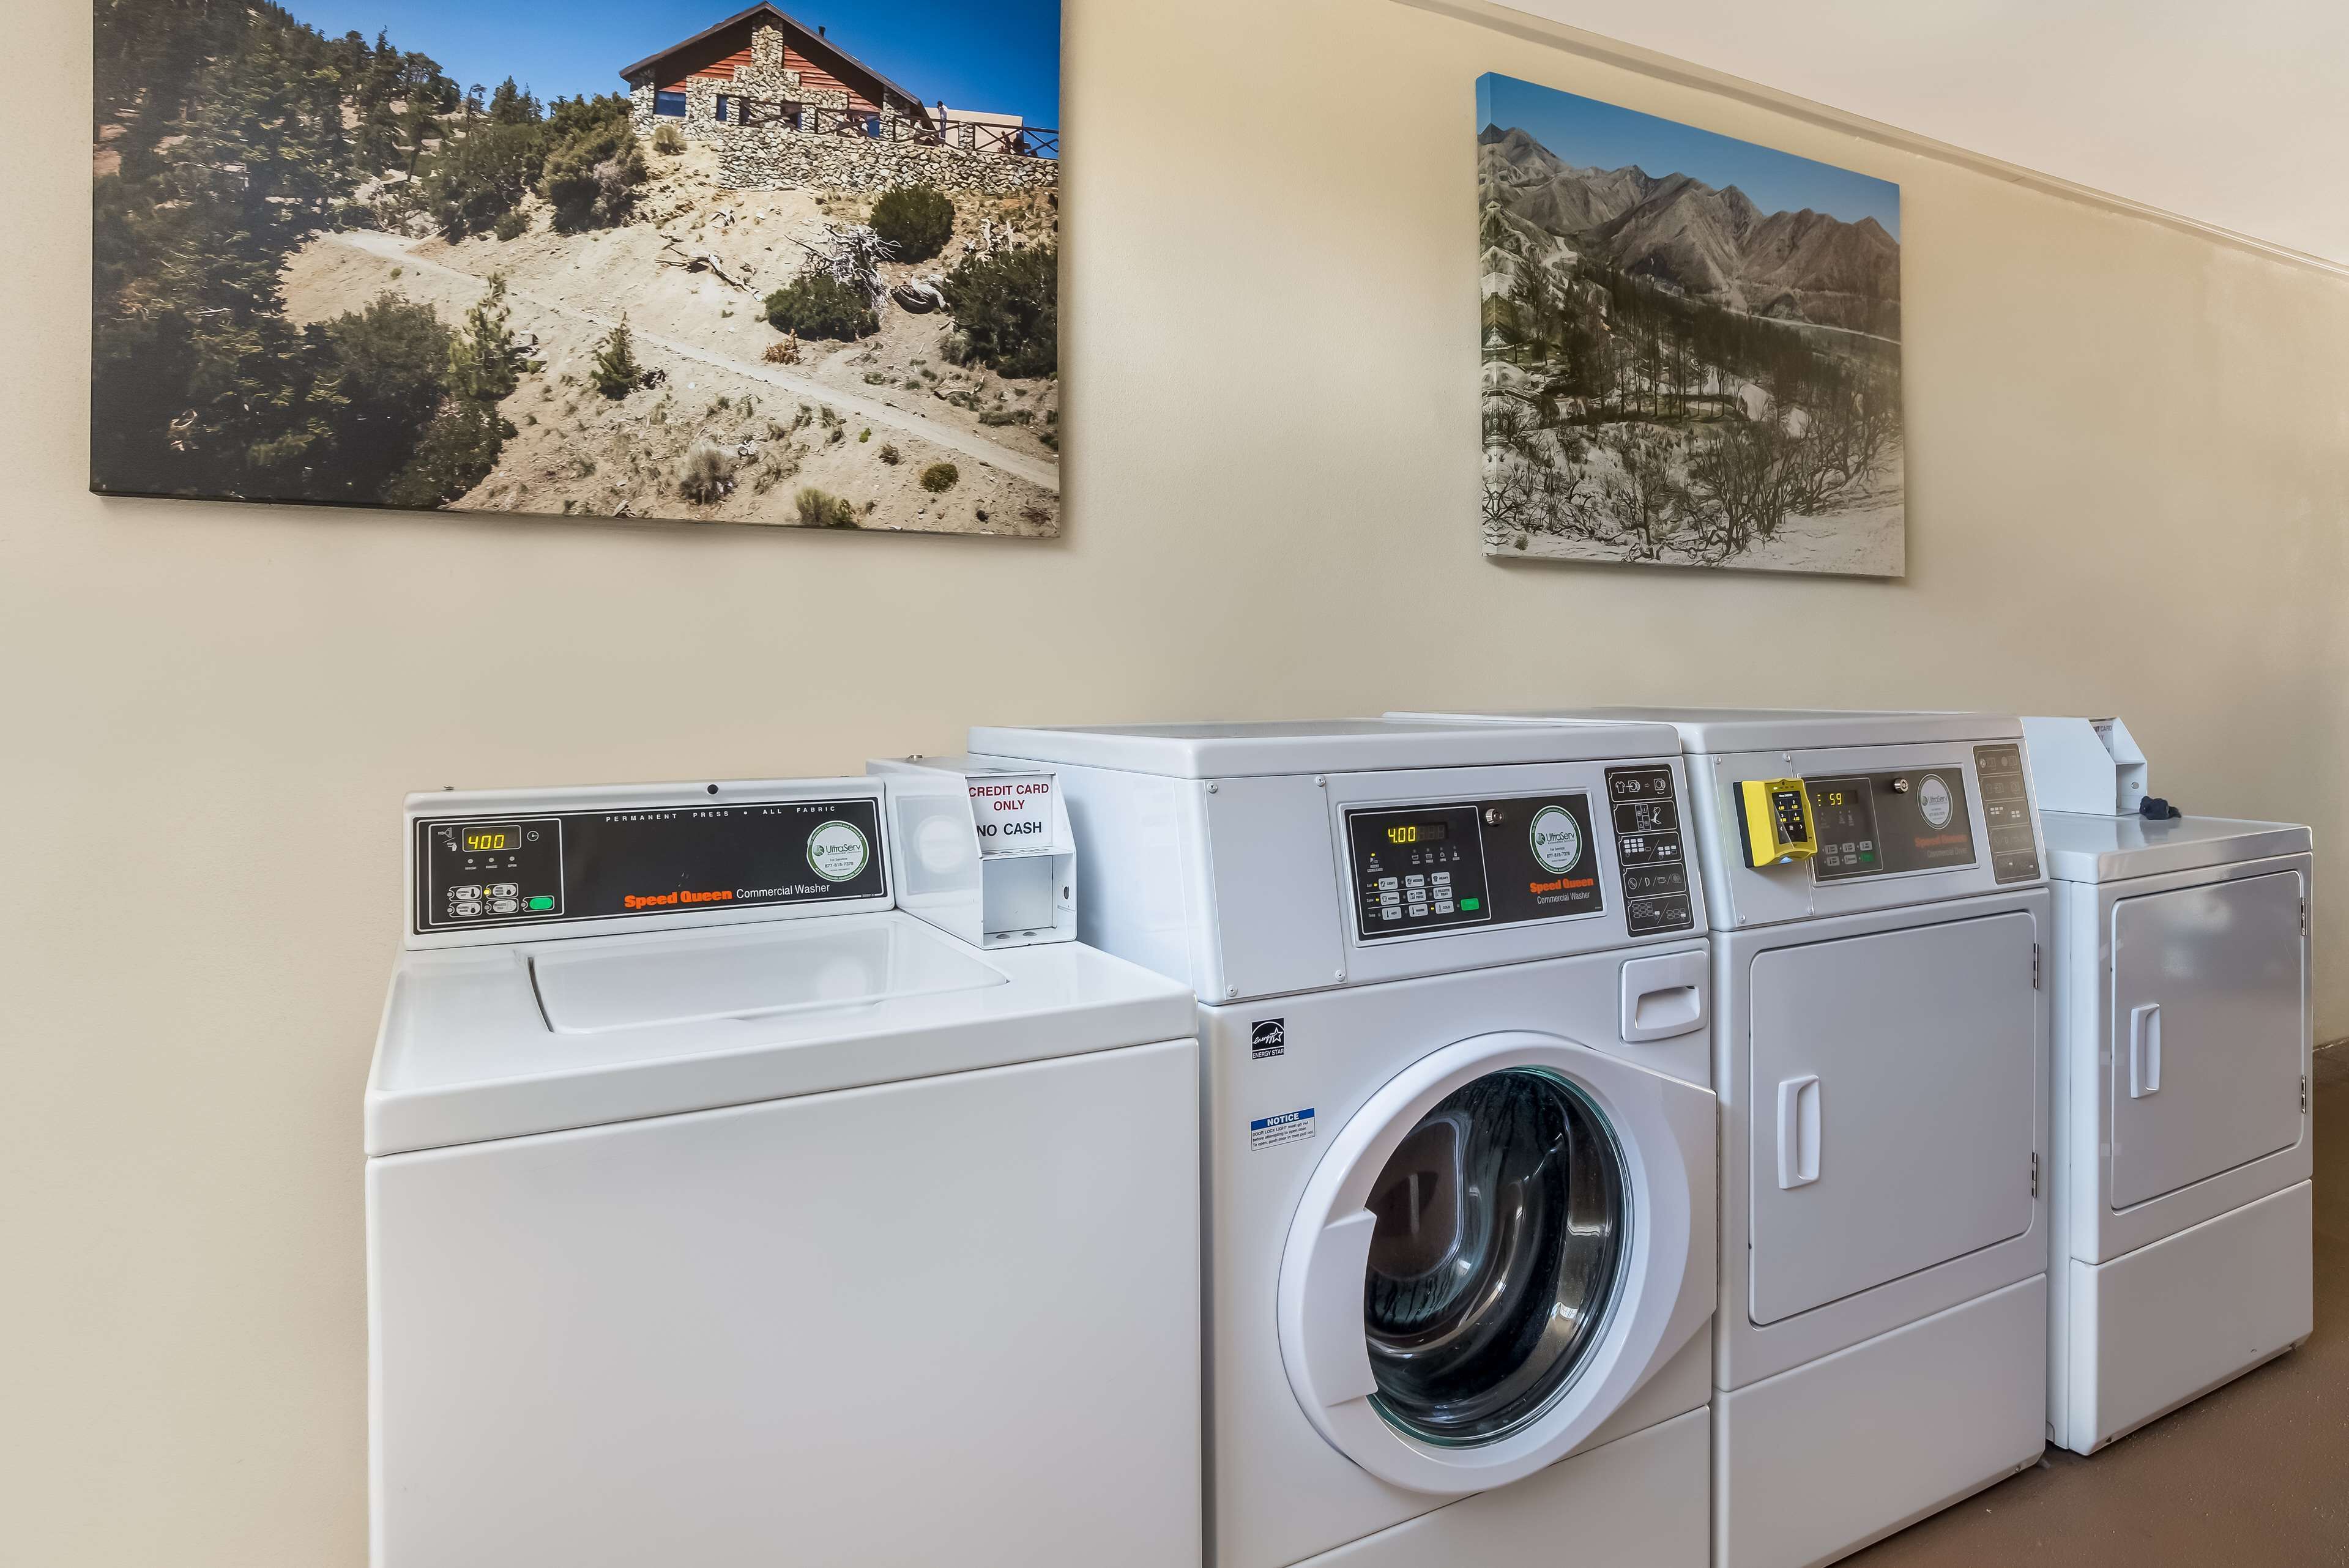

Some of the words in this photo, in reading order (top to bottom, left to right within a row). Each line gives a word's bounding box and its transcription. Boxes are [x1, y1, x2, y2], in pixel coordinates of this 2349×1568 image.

[969, 786, 1013, 797] CREDIT
[1016, 784, 1049, 795] CARD
[994, 800, 1025, 811] ONLY
[1830, 793, 1842, 806] 59
[606, 813, 678, 822] PERMANENT
[977, 824, 997, 837] NO
[1003, 822, 1042, 835] CASH
[1388, 827, 1416, 843] 4.00
[468, 834, 505, 849] 400
[1546, 832, 1575, 842] UltraServ
[825, 844, 861, 853] UltraServ
[736, 885, 793, 899] Commercial
[795, 883, 830, 894] Washer
[1530, 880, 1562, 893] Speed
[1563, 878, 1594, 888] Queen
[624, 892, 678, 909] Speed
[680, 890, 732, 902] Queen
[1537, 893, 1569, 904] Commercial
[1570, 891, 1590, 901] Washer
[1253, 1050, 1271, 1058] ENERGY
[1267, 1112, 1300, 1126] NOTICE
